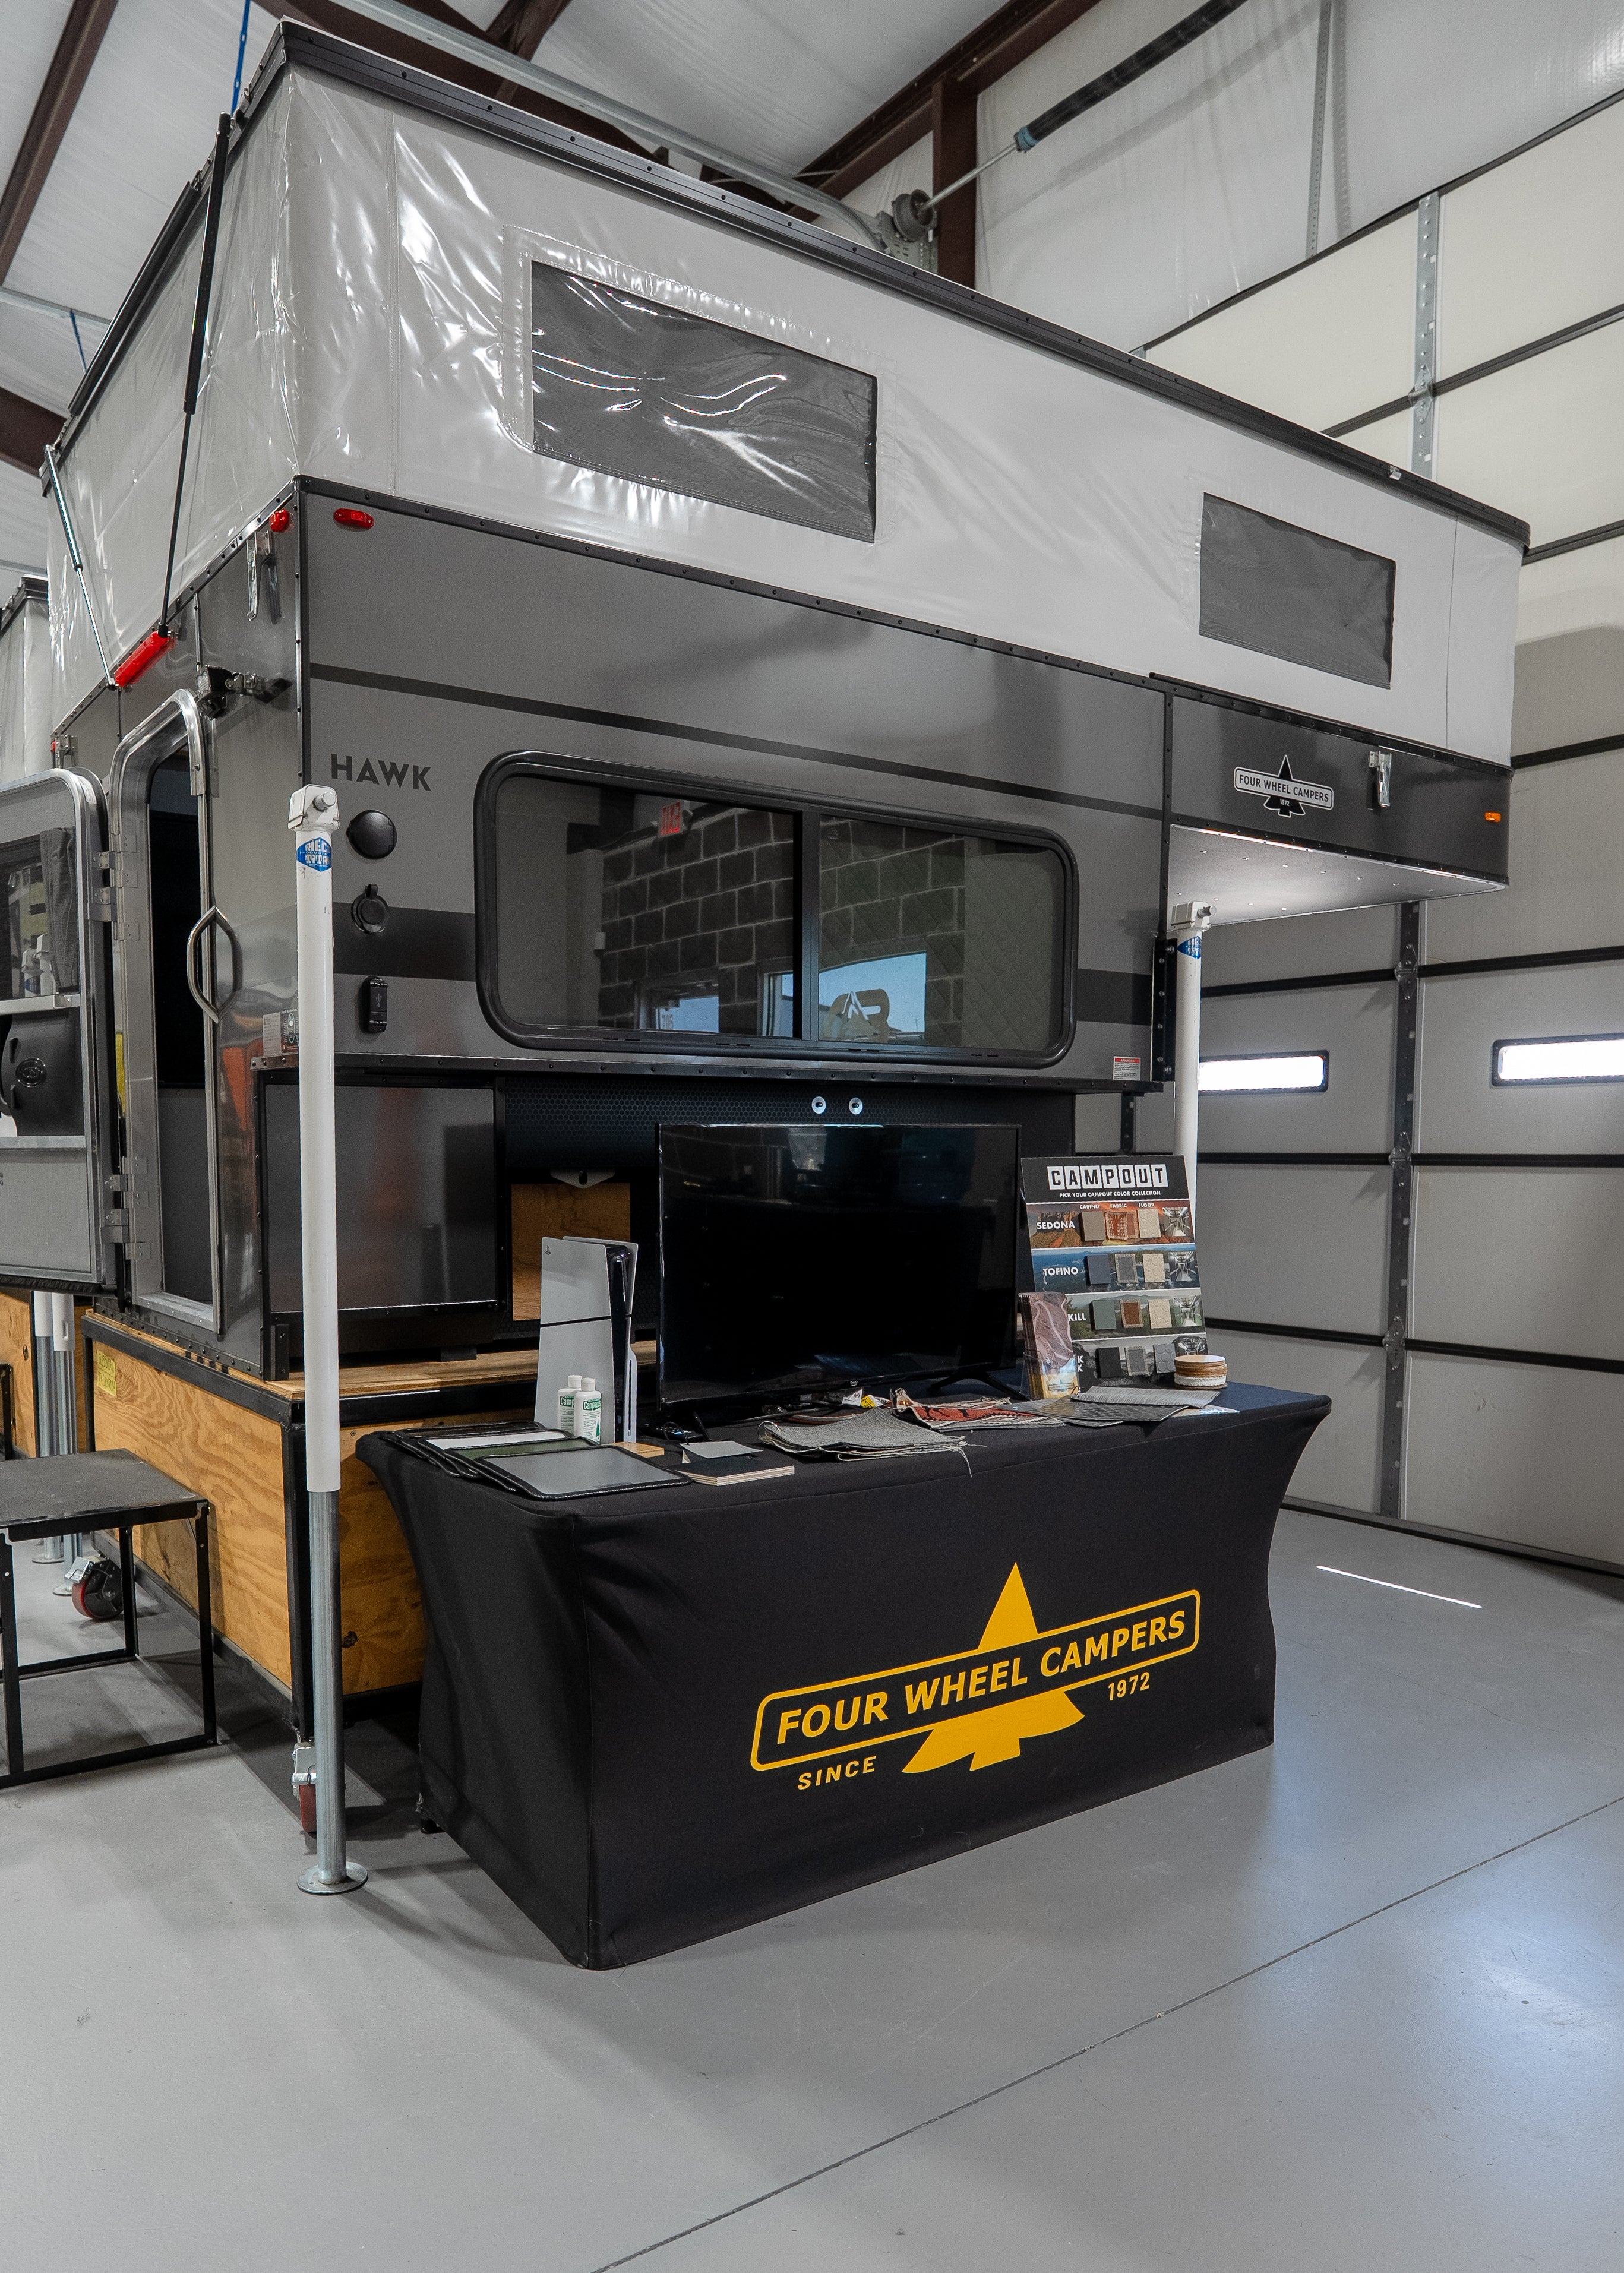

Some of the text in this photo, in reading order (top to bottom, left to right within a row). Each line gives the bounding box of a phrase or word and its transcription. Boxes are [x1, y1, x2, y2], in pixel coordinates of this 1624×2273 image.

[331, 754, 432, 792] HAWK
[1239, 774, 1329, 802] FOUR WHEEL CAMPERS
[1051, 1168, 1163, 1186] CAMPOUT
[1036, 1221, 1076, 1230] SEDONA
[1042, 1266, 1079, 1276] TOFINO
[1068, 1313, 1087, 1322] KILL
[776, 1610, 1186, 1745] FOUR WHEEL CAMPERS
[797, 1672, 1151, 1791] SINCE 1972
